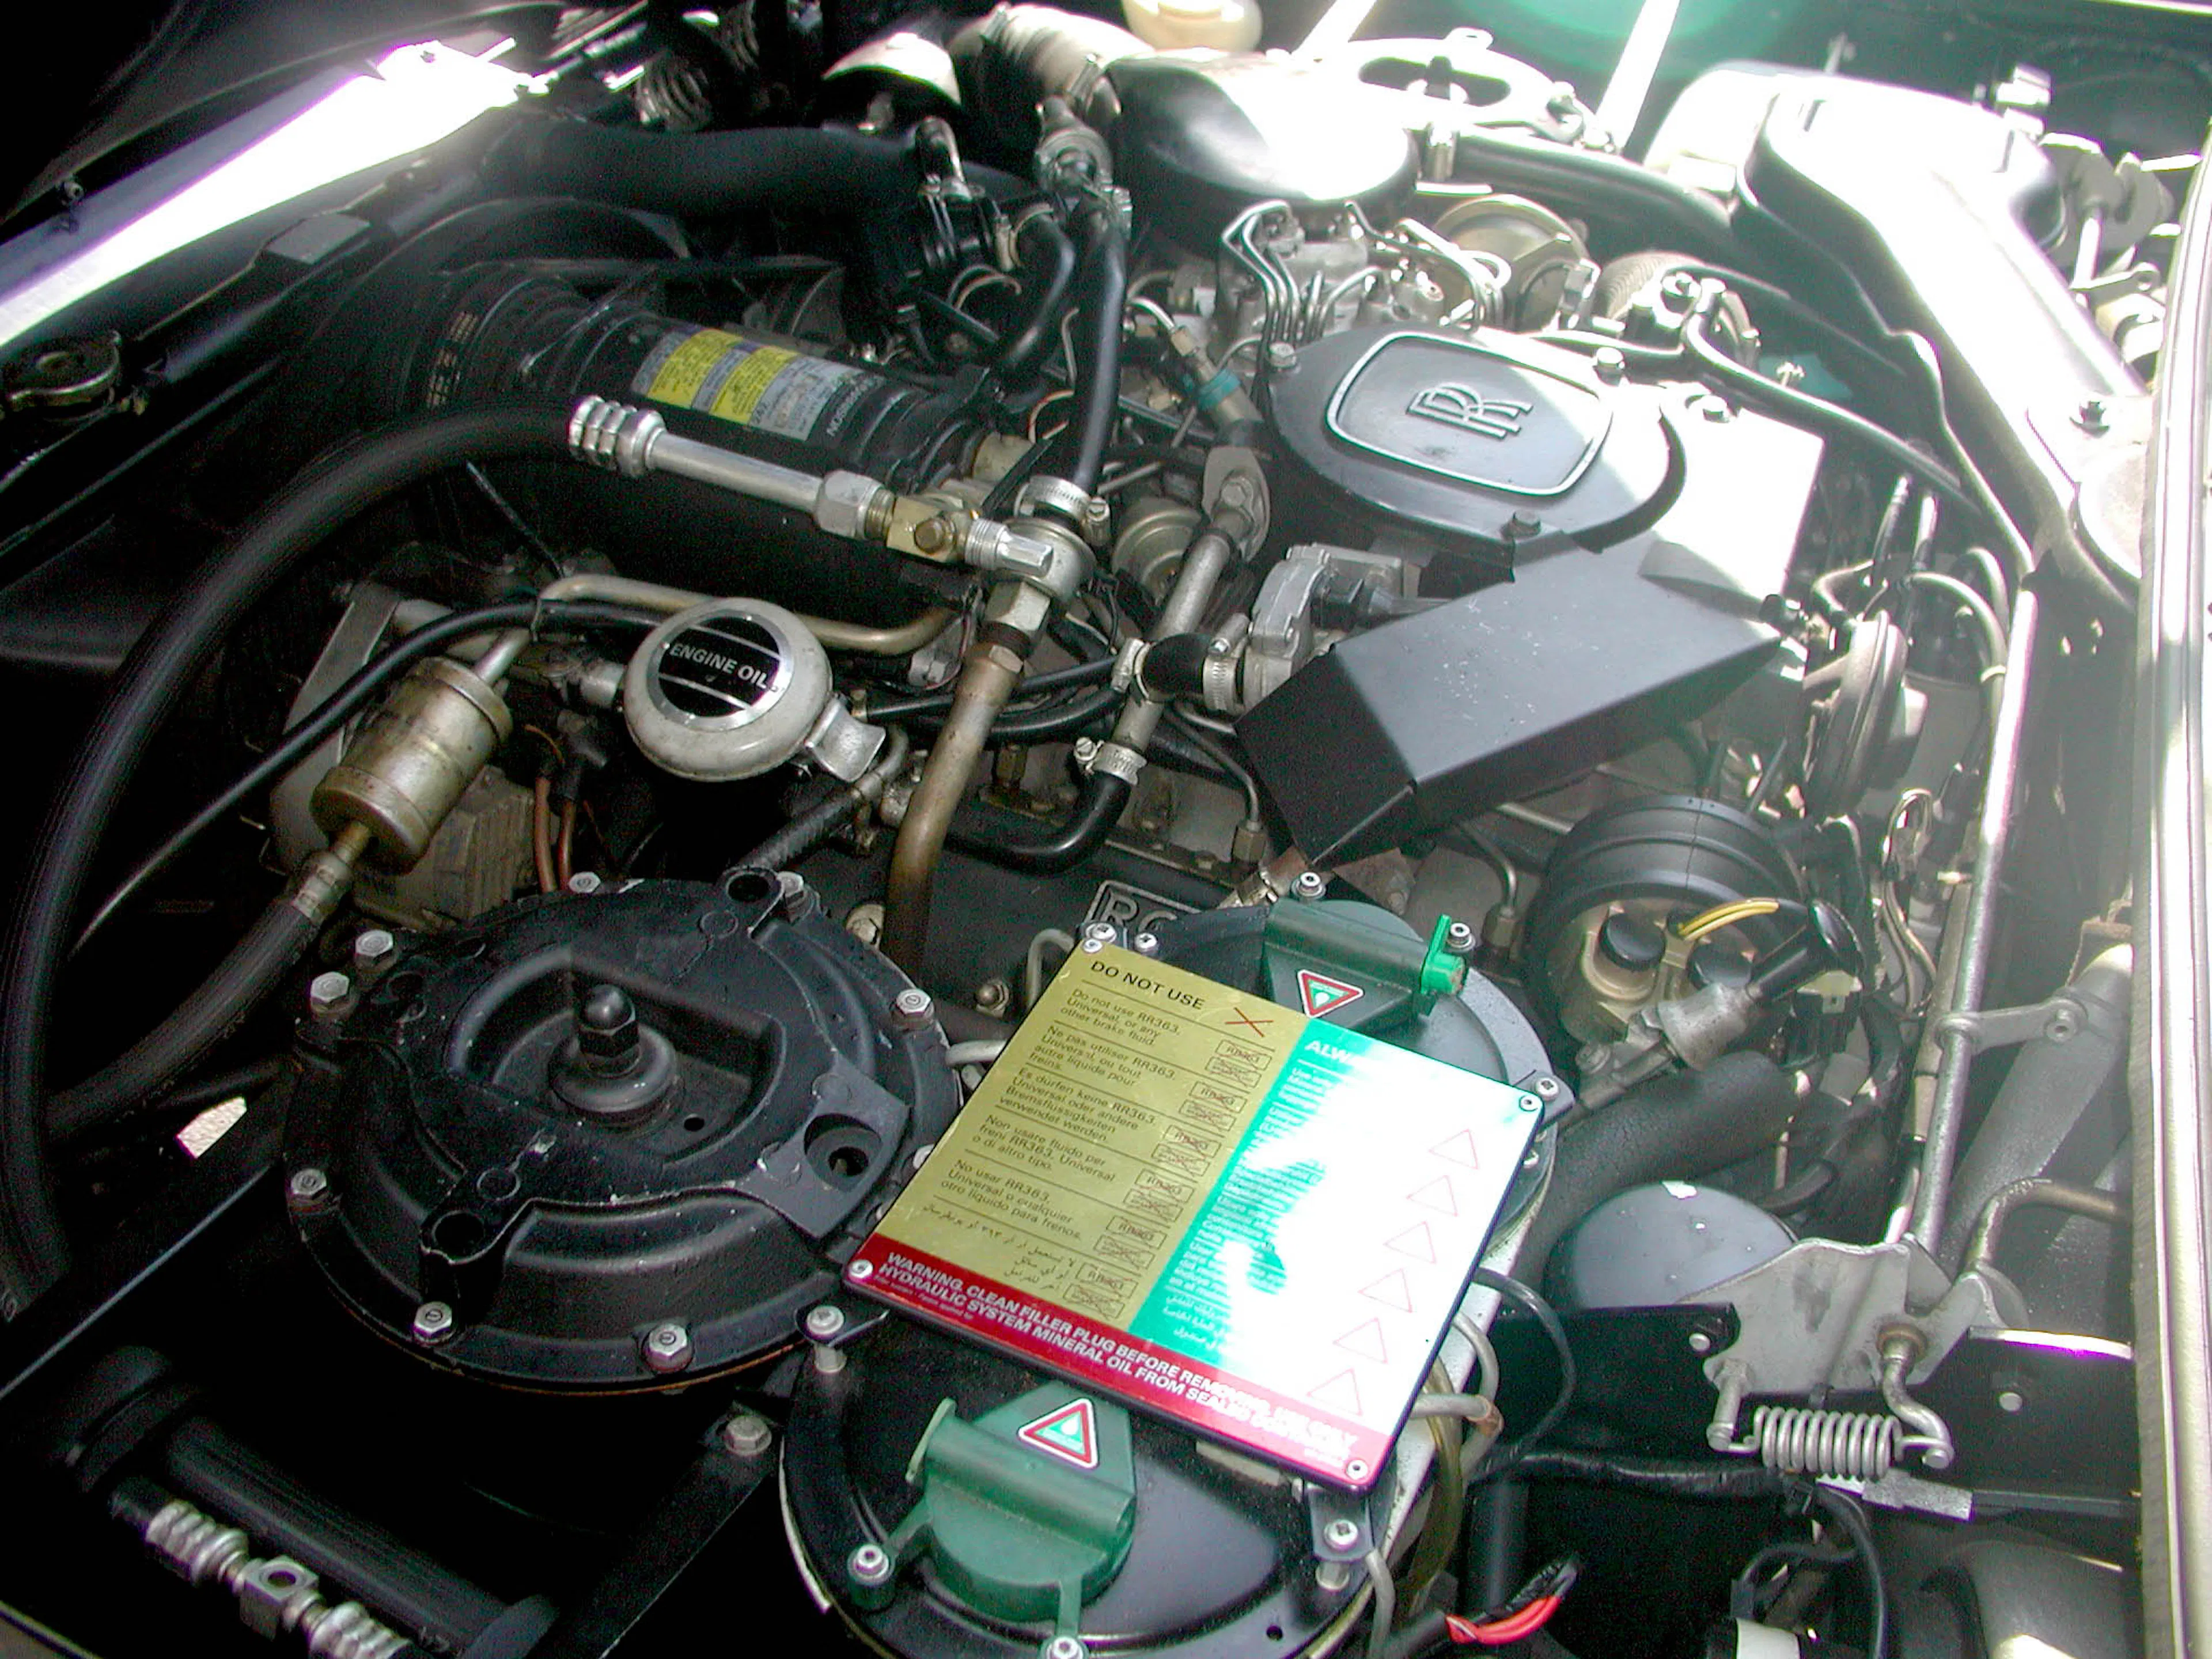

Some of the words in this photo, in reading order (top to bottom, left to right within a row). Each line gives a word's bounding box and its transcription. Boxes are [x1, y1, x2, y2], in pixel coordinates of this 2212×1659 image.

[669, 642, 738, 674] ENGINE
[738, 665, 768, 689] OIL
[1089, 960, 1121, 979] DO
[1121, 971, 1165, 995] NOT
[1165, 988, 1207, 1010] USE
[1070, 988, 1090, 1001] Do
[1090, 996, 1112, 1009] not
[1112, 1005, 1135, 1017] use
[1059, 1005, 1092, 1022] other
[1091, 1017, 1127, 1035] brake
[1123, 1019, 1138, 1029] or
[1137, 1025, 1162, 1039] any
[1046, 1025, 1066, 1037] Ne
[1065, 1033, 1089, 1047] pas
[1105, 1070, 1138, 1088] pour
[971, 1133, 983, 1143] o
[982, 1137, 998, 1149] di
[997, 1142, 1028, 1160] altro
[984, 1114, 1013, 1130] Non
[1084, 1154, 1107, 1168] per
[953, 1158, 976, 1173] No
[876, 1262, 969, 1308] HYDRAULIC
[964, 1297, 1034, 1334] SYSTEM
[1029, 1323, 1109, 1365] MINERAL
[1104, 1353, 1137, 1376] OIL
[1132, 1365, 1187, 1396] FROM
[963, 1283, 1022, 1315] CLEAN
[1017, 1304, 1074, 1335] FILLER
[1071, 1325, 1118, 1353] PLUG
[1113, 1343, 1181, 1379] BEFORE
